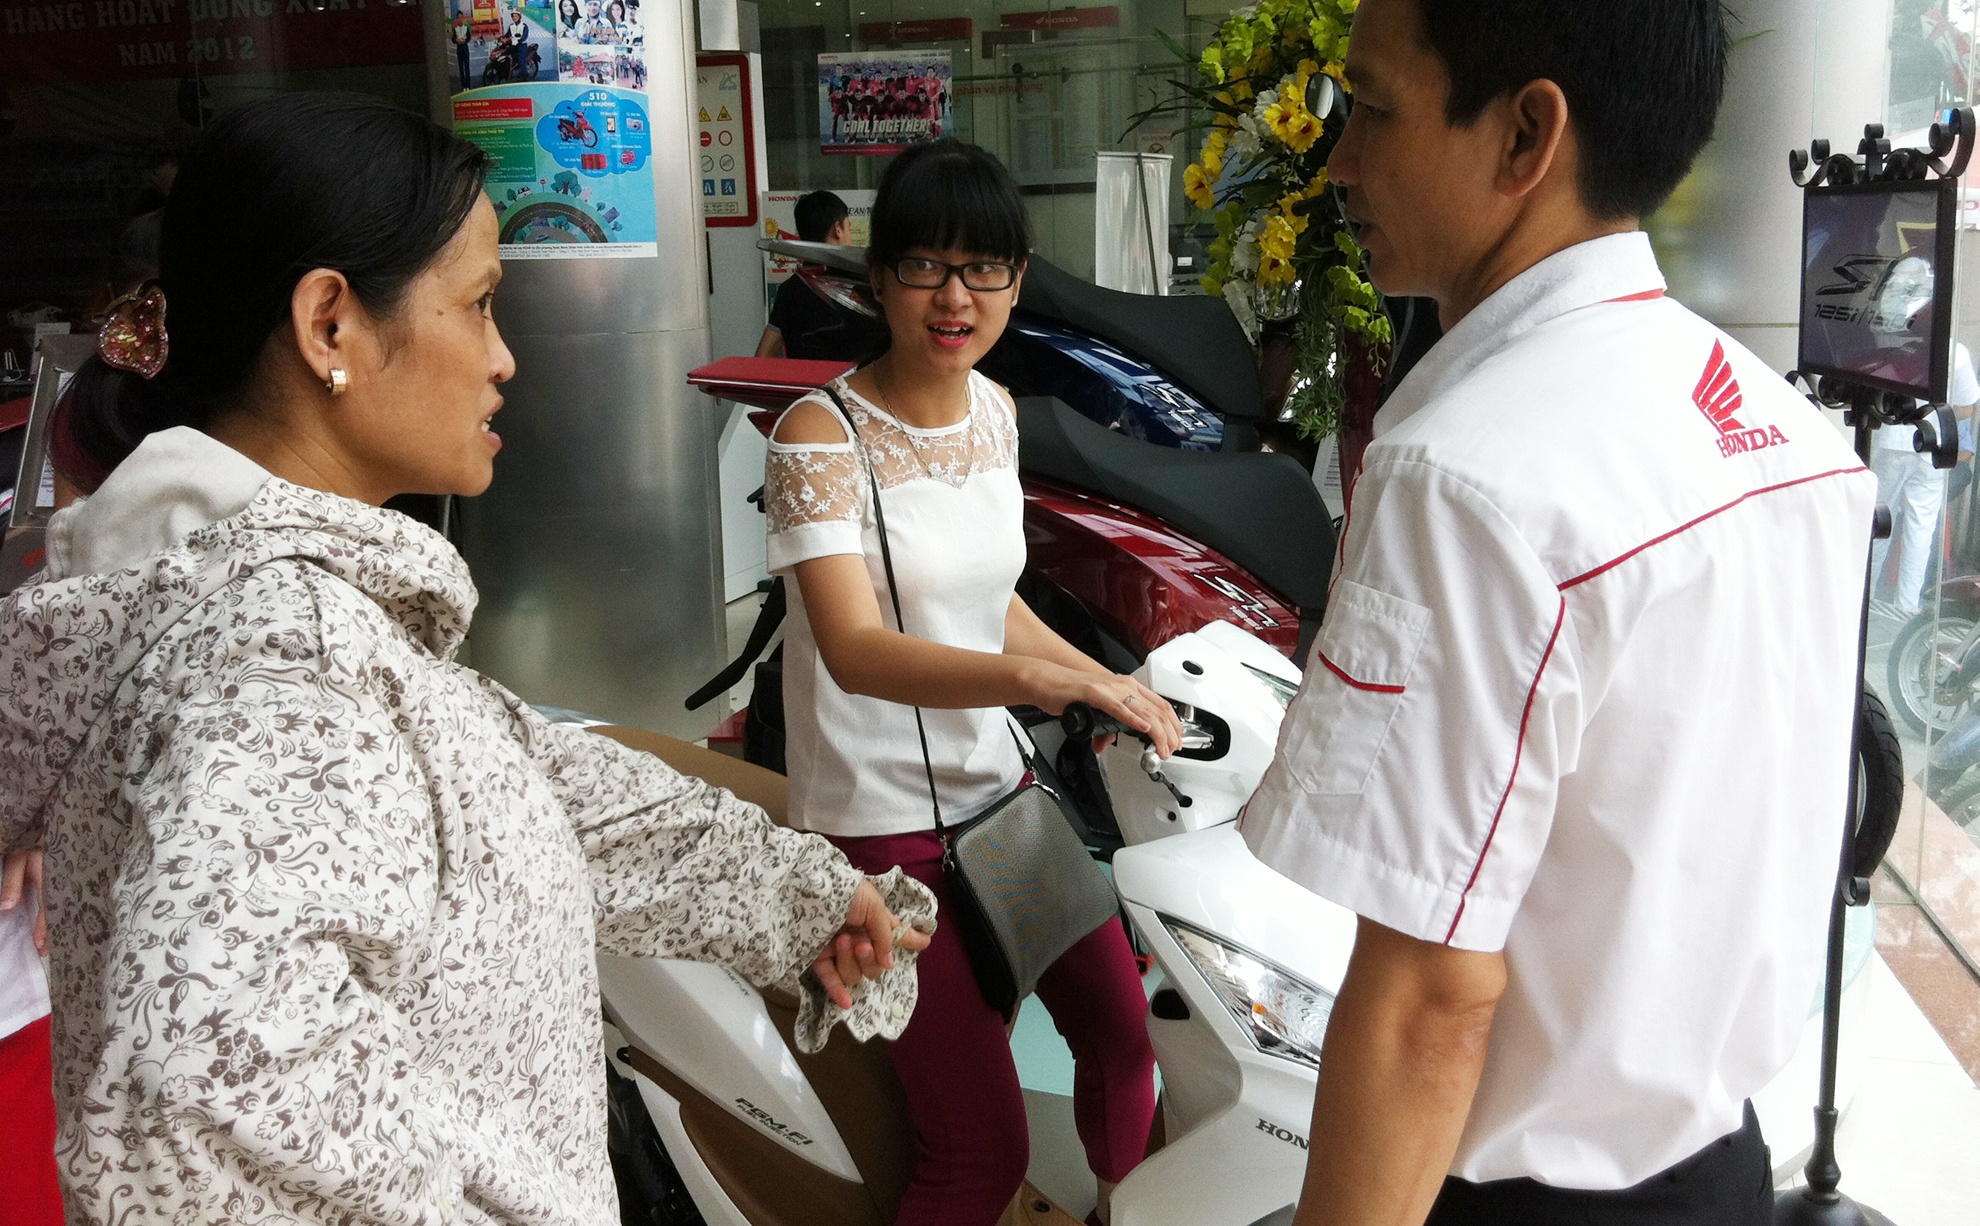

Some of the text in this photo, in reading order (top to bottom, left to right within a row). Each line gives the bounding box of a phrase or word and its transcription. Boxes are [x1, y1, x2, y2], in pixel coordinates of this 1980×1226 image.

[186, 36, 256, 63] 2012
[588, 92, 607, 101] 510
[843, 120, 870, 133] GOAL
[1716, 424, 1790, 459] HONDA
